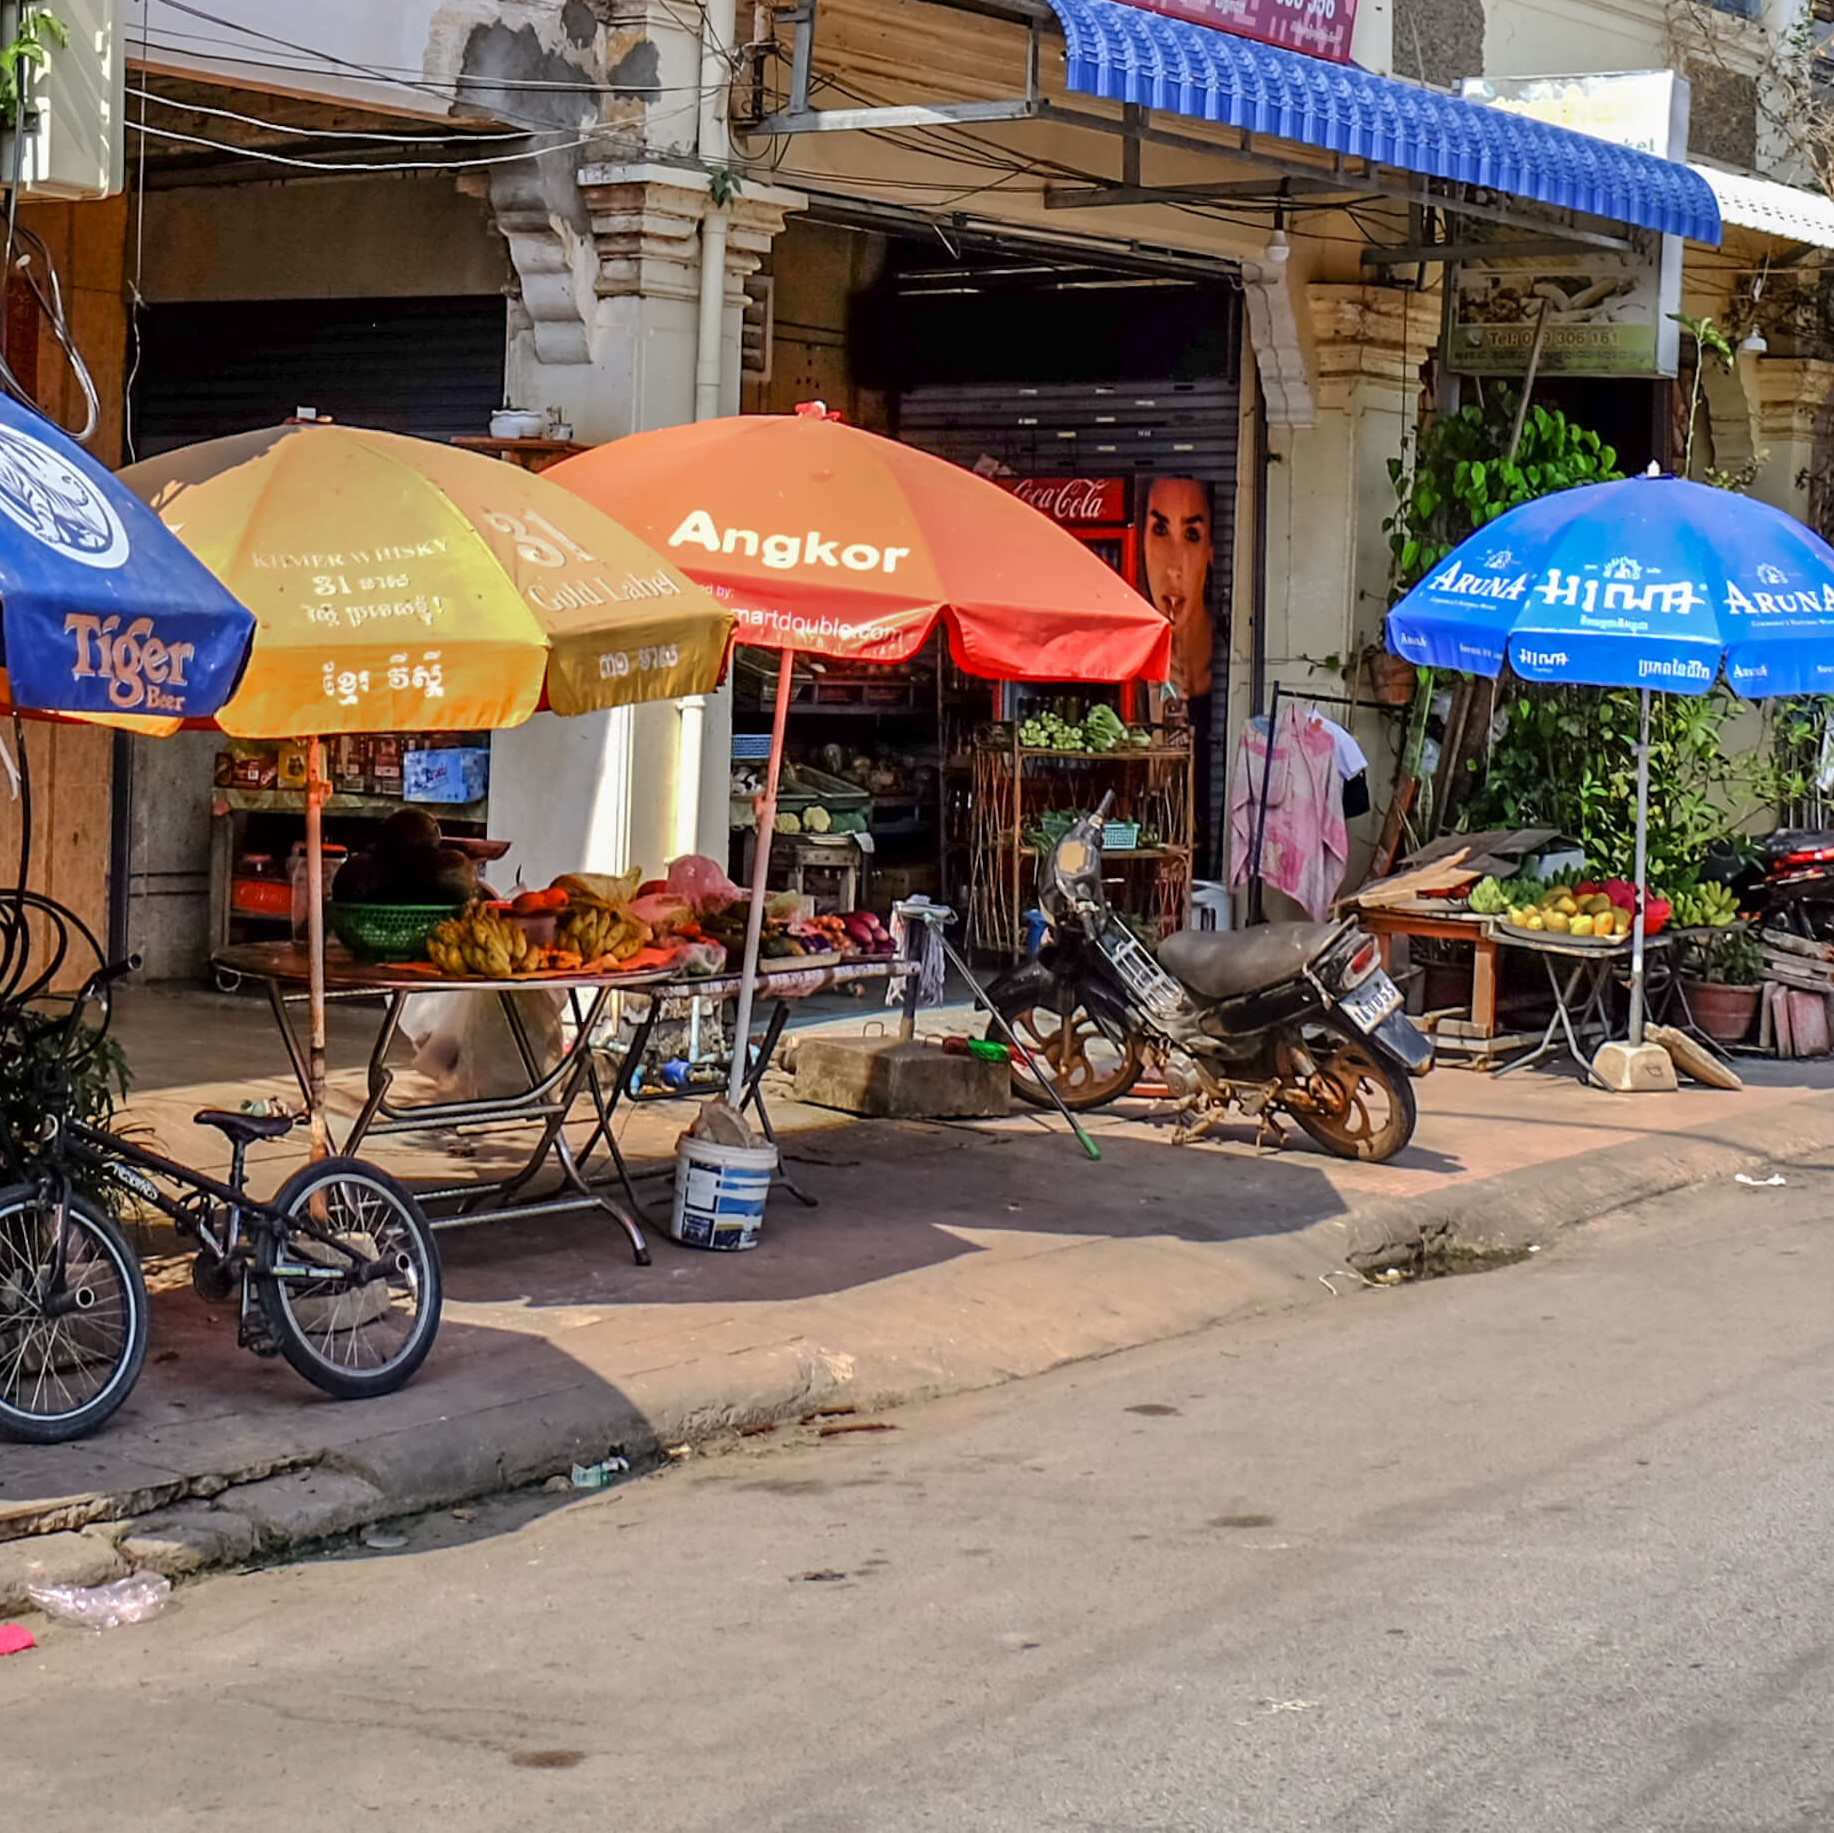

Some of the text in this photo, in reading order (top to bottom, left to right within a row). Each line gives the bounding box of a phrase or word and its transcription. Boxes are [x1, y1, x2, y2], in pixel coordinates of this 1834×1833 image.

[1522, 331, 1552, 346] 09
[482, 510, 596, 567] 31
[668, 510, 911, 573] Angkor
[312, 575, 351, 596] 31
[528, 568, 681, 612] Gold Label
[1427, 559, 1529, 601] ARUNA
[64, 613, 195, 708] Tiger
[145, 684, 186, 711] Beer
